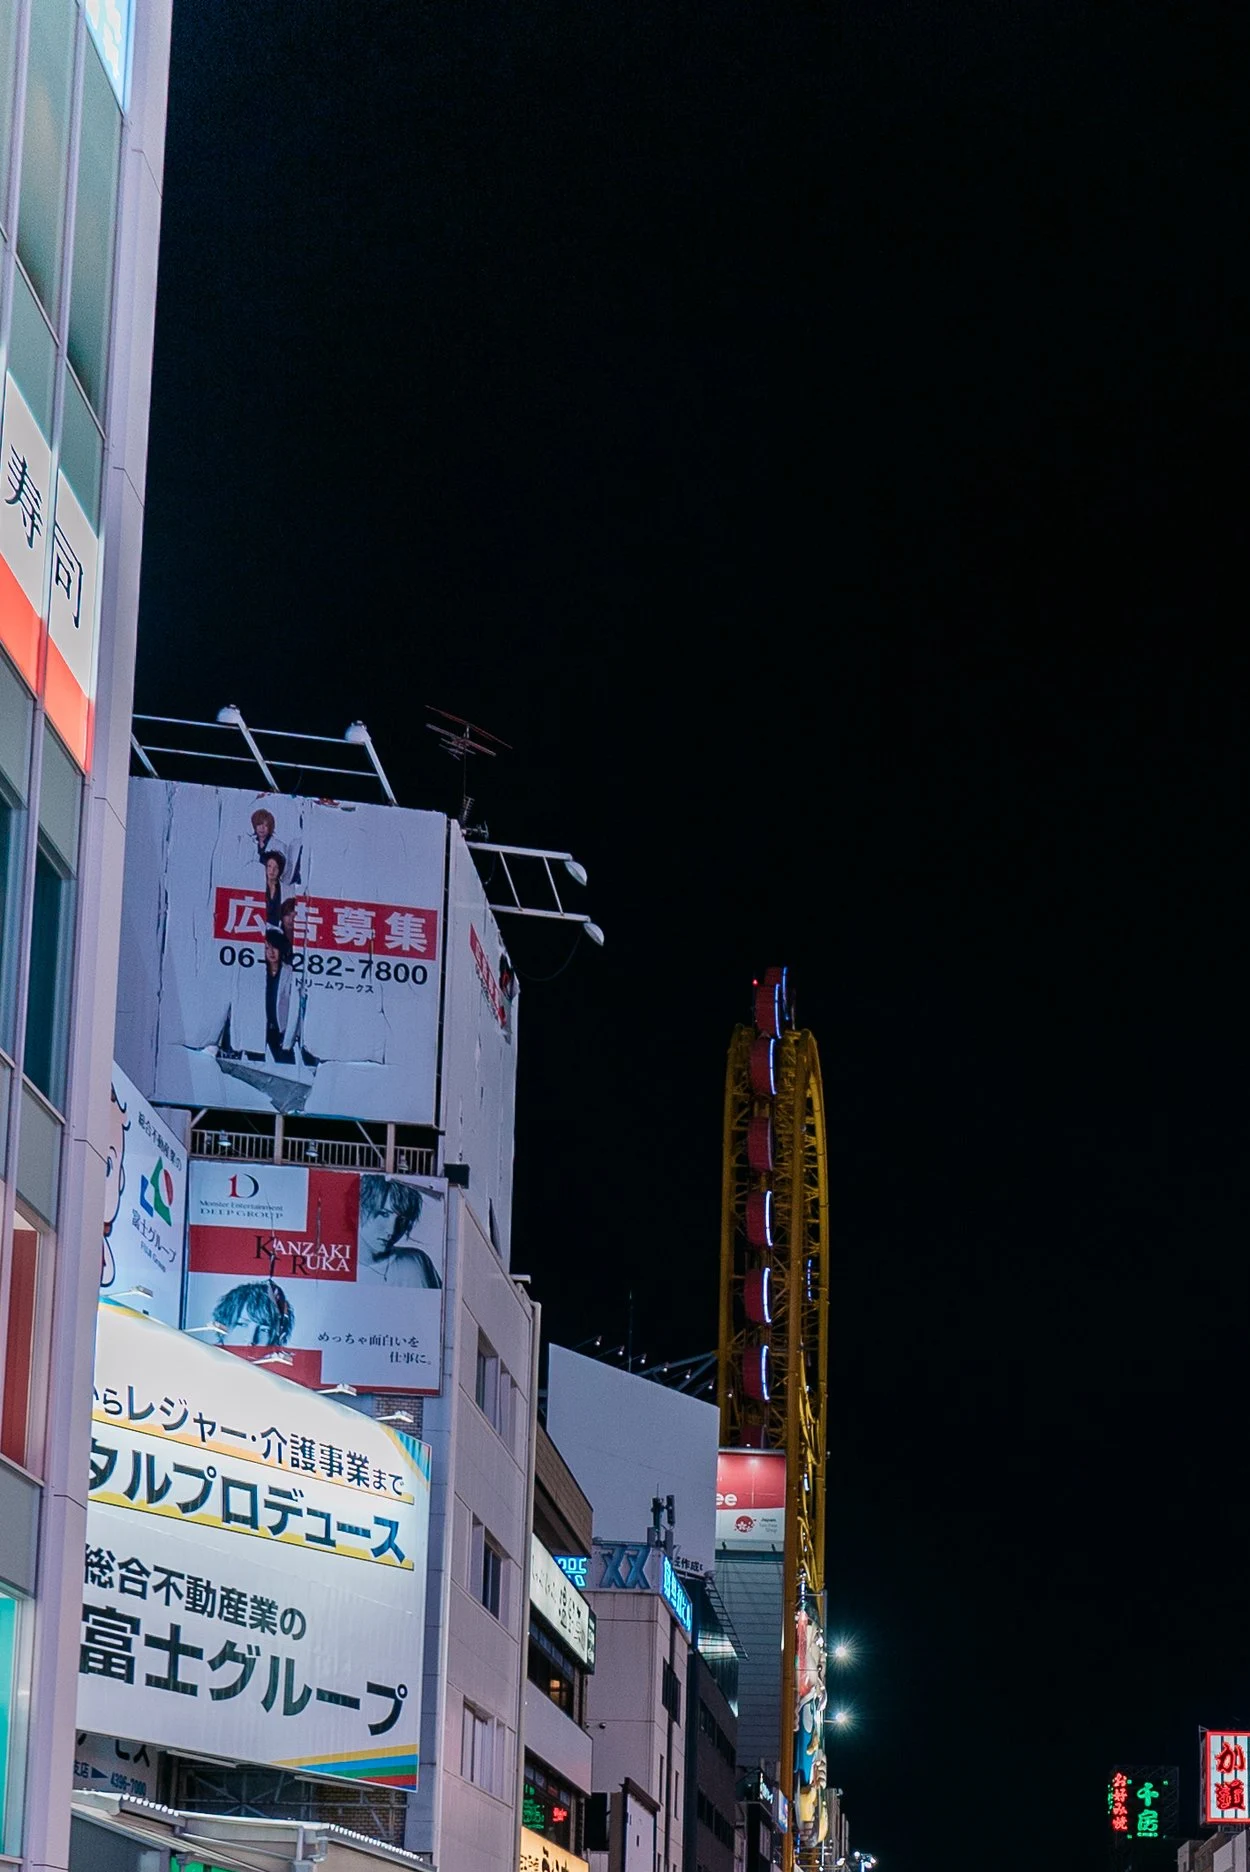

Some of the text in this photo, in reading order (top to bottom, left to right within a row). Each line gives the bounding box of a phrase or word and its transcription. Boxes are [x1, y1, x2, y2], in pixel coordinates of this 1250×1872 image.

[5, 444, 84, 629] 寿司
[223, 895, 429, 953] 広告募集
[219, 945, 428, 985] 06-282-7800
[255, 1234, 351, 1261] KANZAKI
[291, 1253, 350, 1276] RUKA
[317, 1331, 420, 1348] めっちゃ面白いを
[83, 1543, 307, 1640] 総合不動産業の
[79, 1602, 408, 1737] 富士グループ
[1136, 1781, 1160, 1832] 千房
